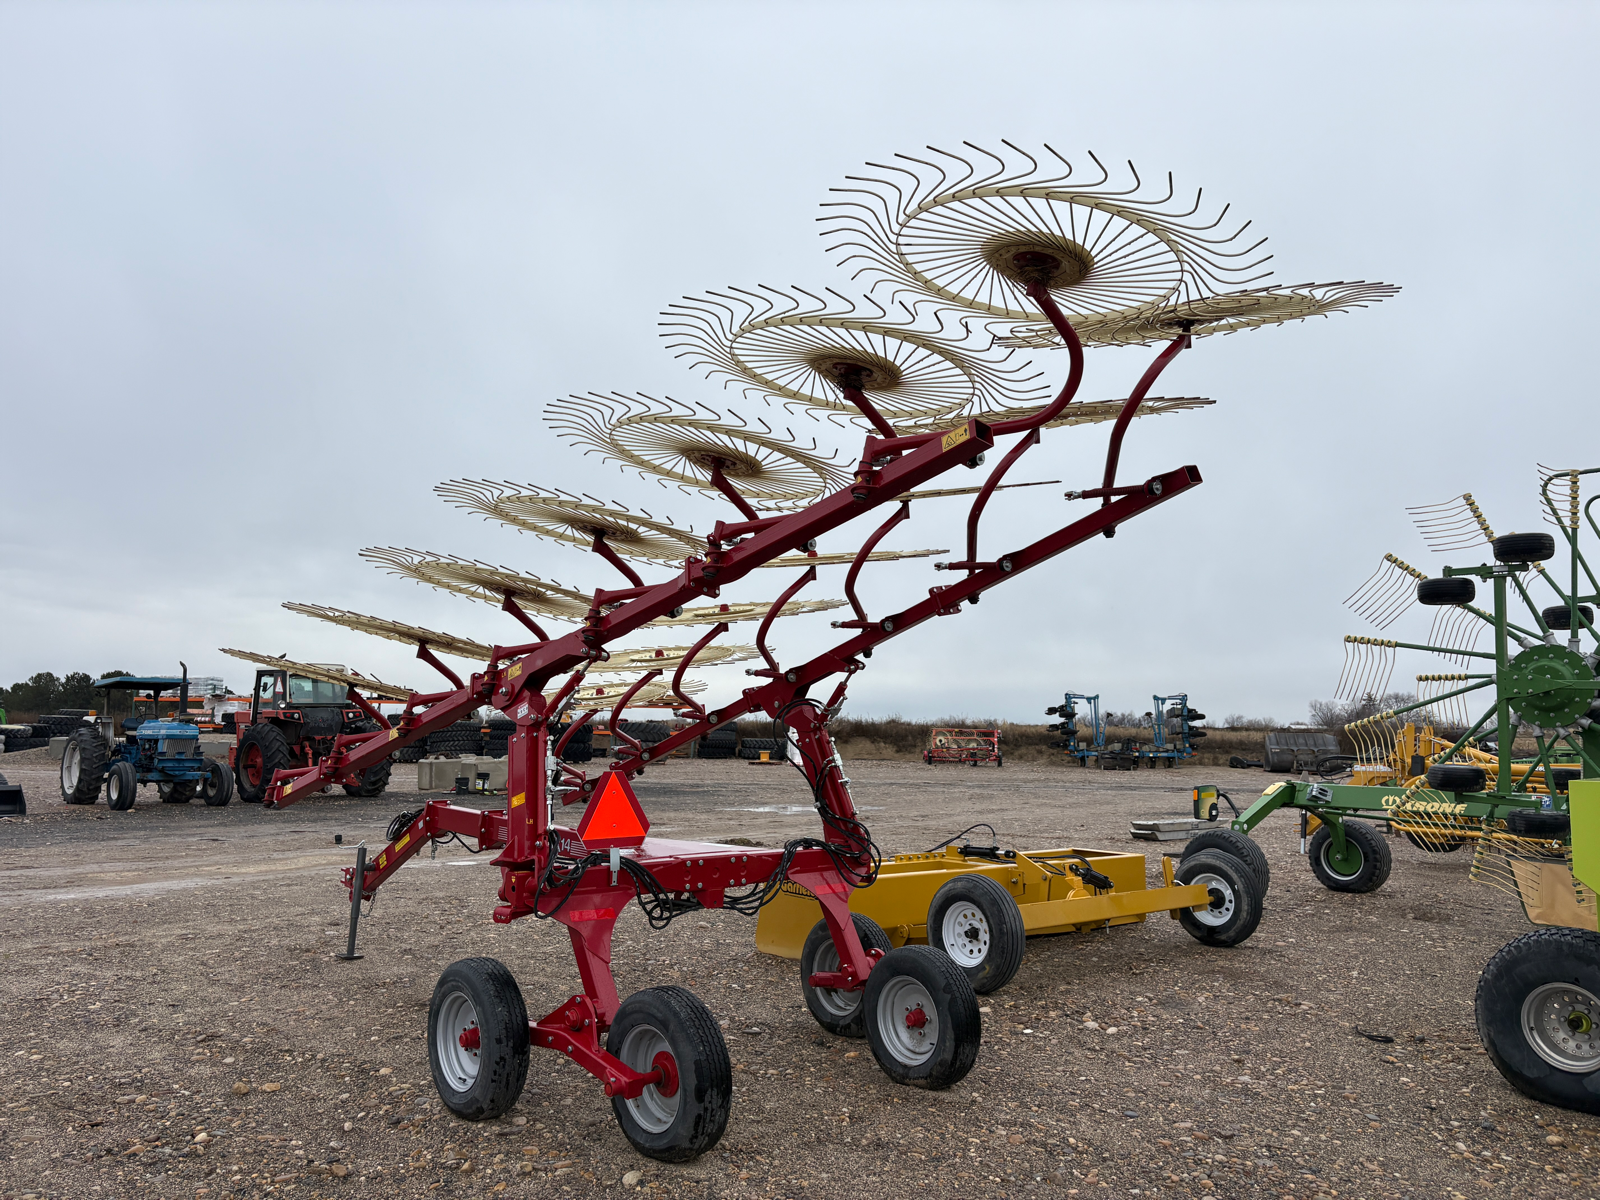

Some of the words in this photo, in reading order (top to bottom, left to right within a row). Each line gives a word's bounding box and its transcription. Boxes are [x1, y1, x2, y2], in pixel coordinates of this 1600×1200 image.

[1404, 800, 1468, 814] KRONE
[526, 817, 534, 825] LH
[556, 837, 571, 853] 14
